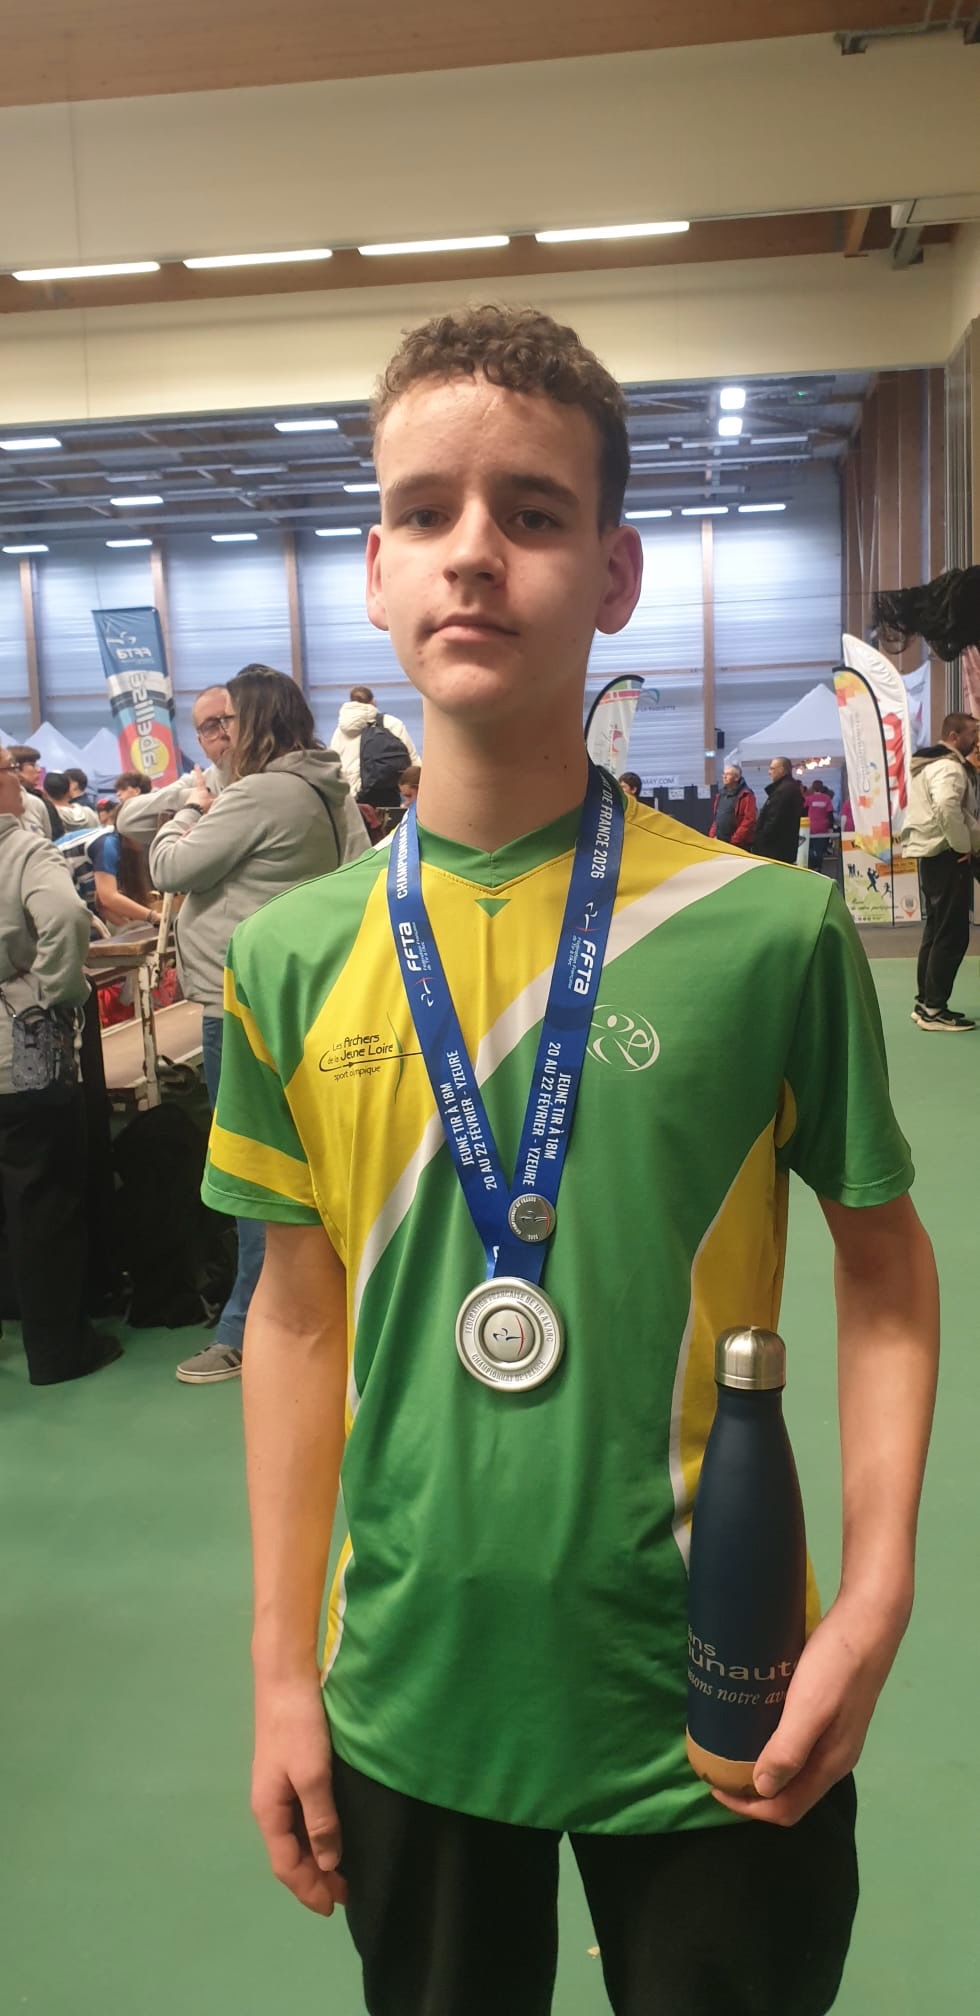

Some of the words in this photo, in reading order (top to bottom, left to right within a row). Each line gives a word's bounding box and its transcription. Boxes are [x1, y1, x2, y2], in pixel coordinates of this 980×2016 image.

[596, 804, 613, 848] FRANCE
[396, 823, 409, 900] CHAMPIONNAT
[590, 849, 608, 879] 2026
[344, 1034, 380, 1048] Archers
[368, 1042, 393, 1055] Loire
[546, 1041, 561, 1057] 20
[446, 1049, 468, 1090] YZEURE
[543, 1058, 558, 1073] AU
[440, 1082, 456, 1105] 18M
[540, 1076, 555, 1091] 22
[554, 1072, 572, 1105] JEUNE
[450, 1114, 465, 1134] TIR
[460, 1097, 483, 1141] FÉVRIER
[531, 1092, 552, 1136] FÉVRIER
[550, 1107, 567, 1123] TIR
[455, 1134, 475, 1166] JEUNE
[474, 1141, 488, 1157] 22
[543, 1137, 559, 1160] 18M
[478, 1158, 493, 1173] AU
[522, 1147, 542, 1187] YZEURE
[483, 1175, 498, 1191] 20
[688, 1624, 716, 1657] ins
[688, 1640, 796, 1681] unaut
[688, 1667, 713, 1696] sons
[716, 1688, 760, 1705] notre
[764, 1689, 786, 1705] av
